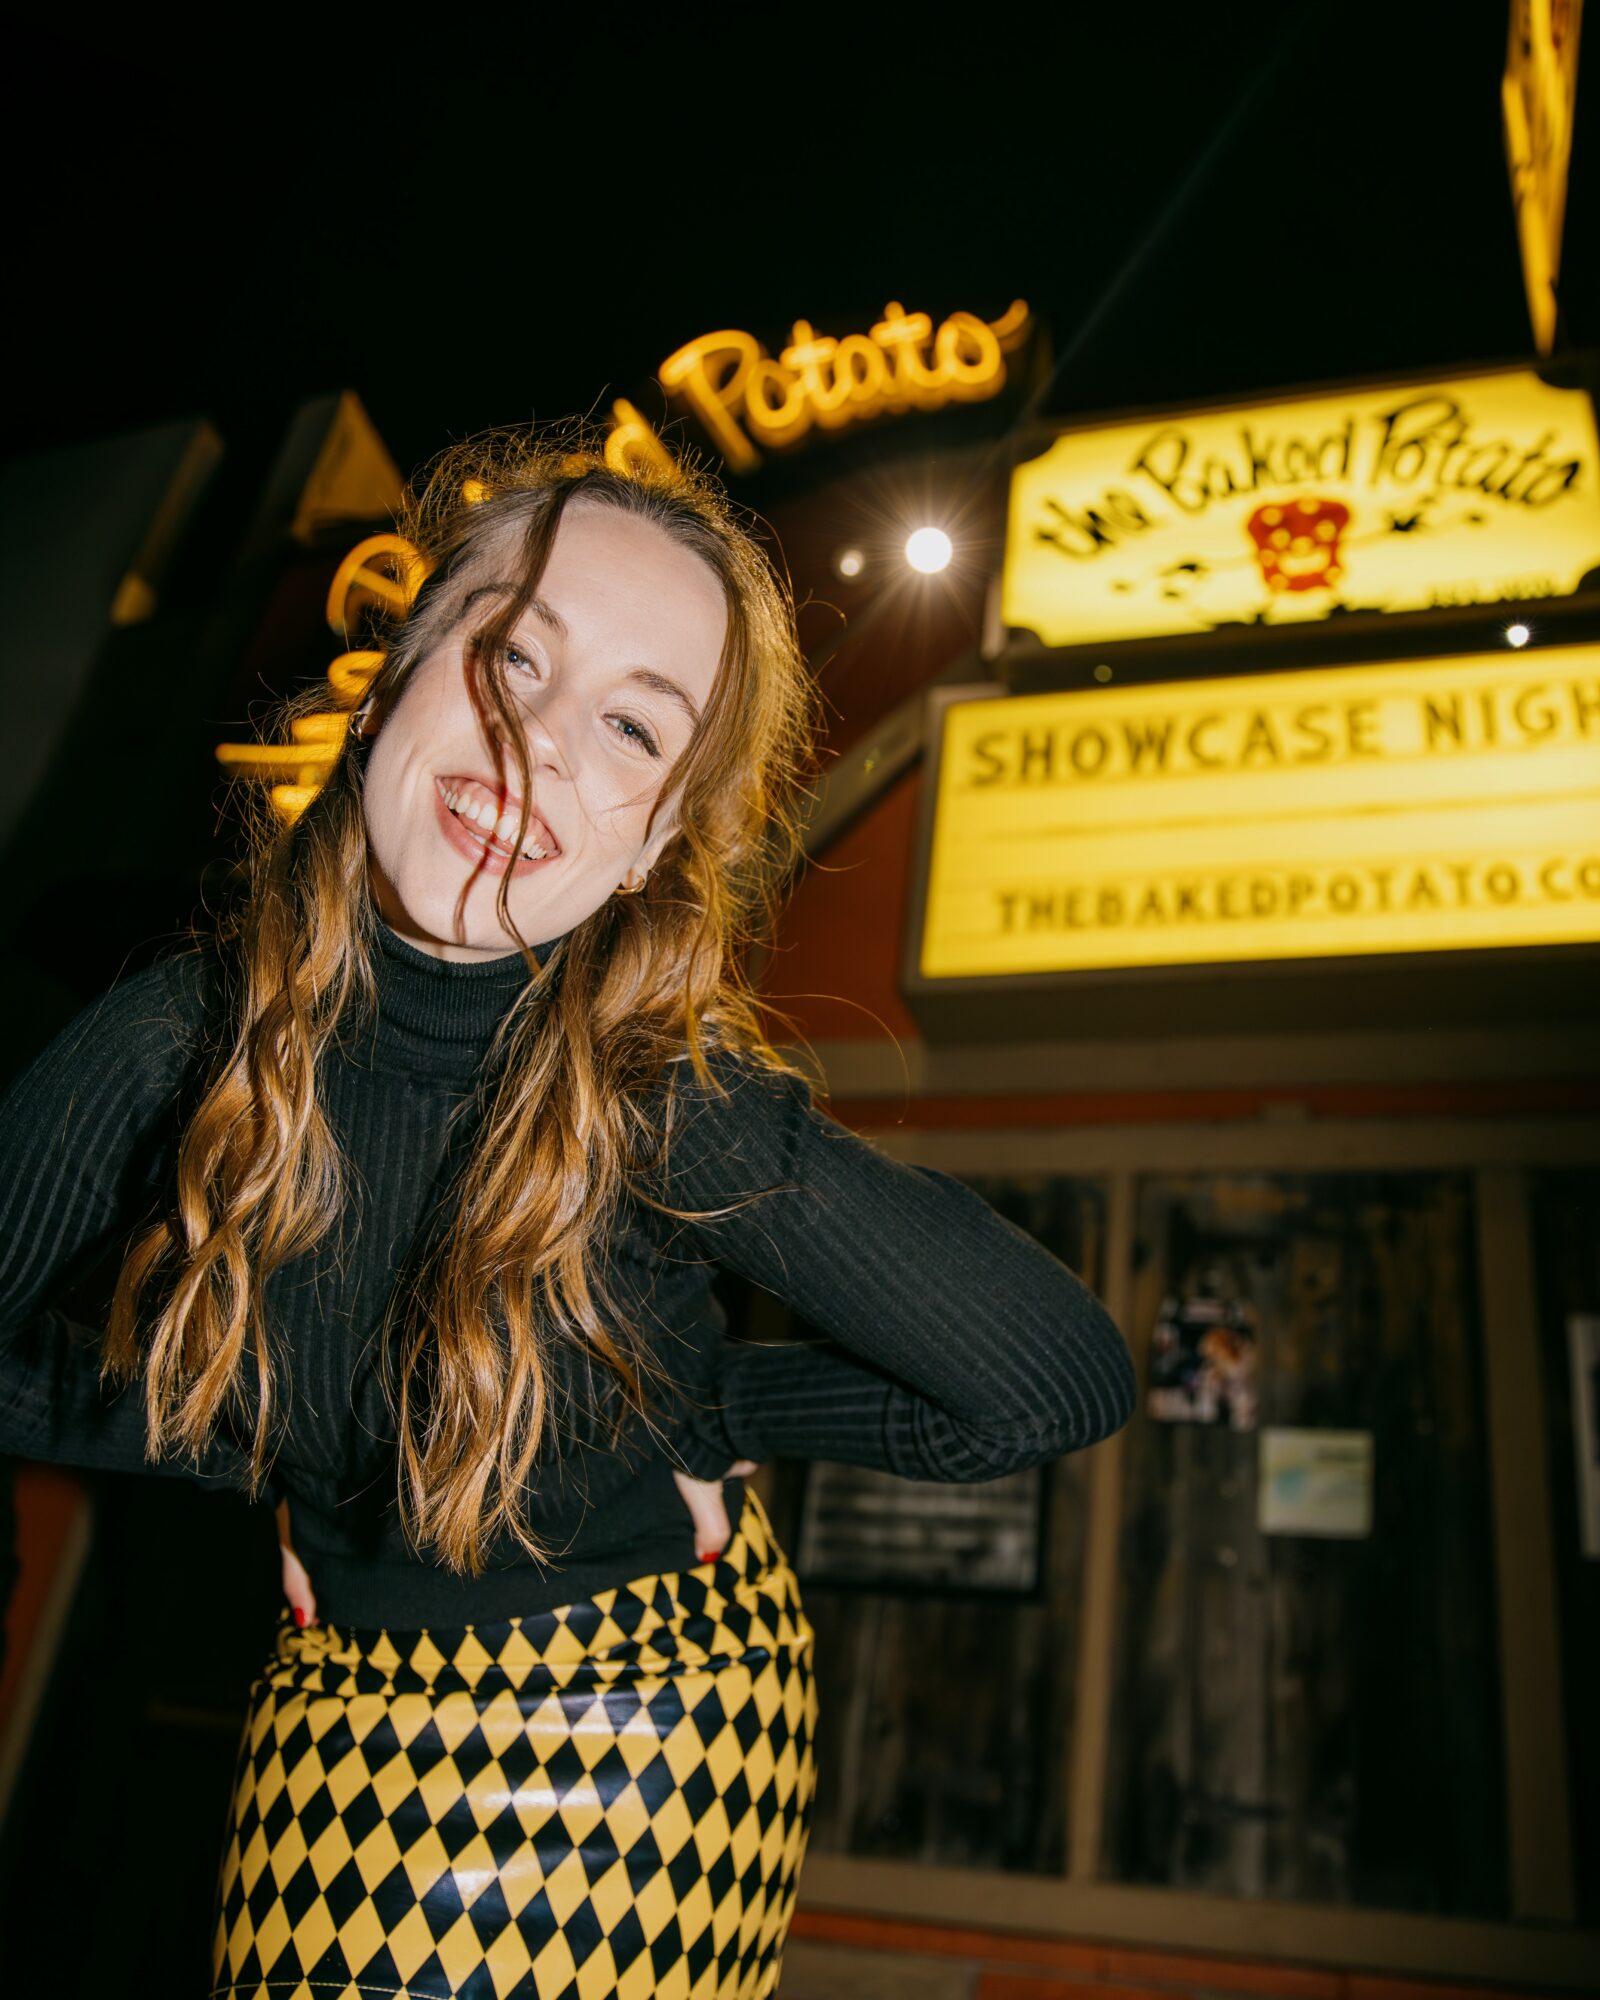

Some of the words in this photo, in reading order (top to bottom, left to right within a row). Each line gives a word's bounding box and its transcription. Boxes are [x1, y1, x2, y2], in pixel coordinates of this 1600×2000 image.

[658, 299, 1029, 475] Potato
[1129, 412, 1357, 514] Baked
[1371, 390, 1583, 508] Potato
[970, 702, 1384, 788] SHOWCASE
